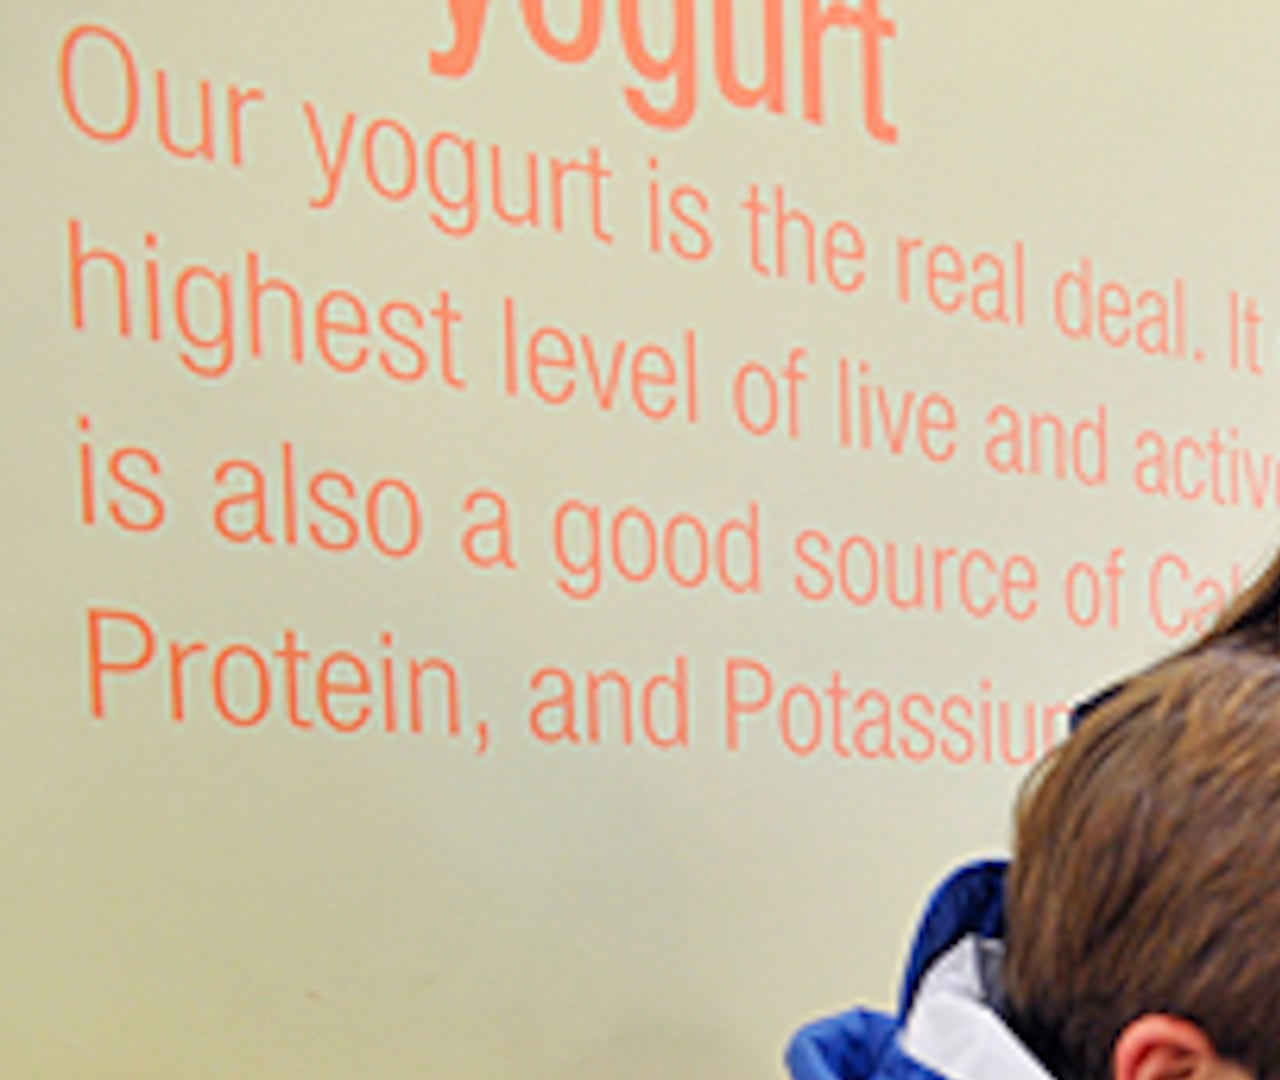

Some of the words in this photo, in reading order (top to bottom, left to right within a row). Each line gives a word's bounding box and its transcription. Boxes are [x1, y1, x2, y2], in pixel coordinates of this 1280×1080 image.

[56, 22, 266, 169] Our
[301, 99, 615, 247] yogurt
[647, 154, 715, 263] is
[740, 182, 868, 294] the
[896, 236, 1027, 327] real
[1053, 256, 1207, 362] deal.
[1228, 290, 1265, 377] It
[66, 215, 468, 392] highest
[502, 295, 700, 425] level
[732, 346, 810, 440] of
[837, 356, 959, 464] live
[985, 403, 1109, 488] and
[75, 412, 168, 535] is
[211, 439, 425, 560] also
[460, 486, 519, 571] a
[551, 497, 764, 602] good
[793, 529, 1040, 623] source
[1065, 546, 1127, 629] of
[85, 605, 492, 756] Protein,
[528, 654, 690, 753] and
